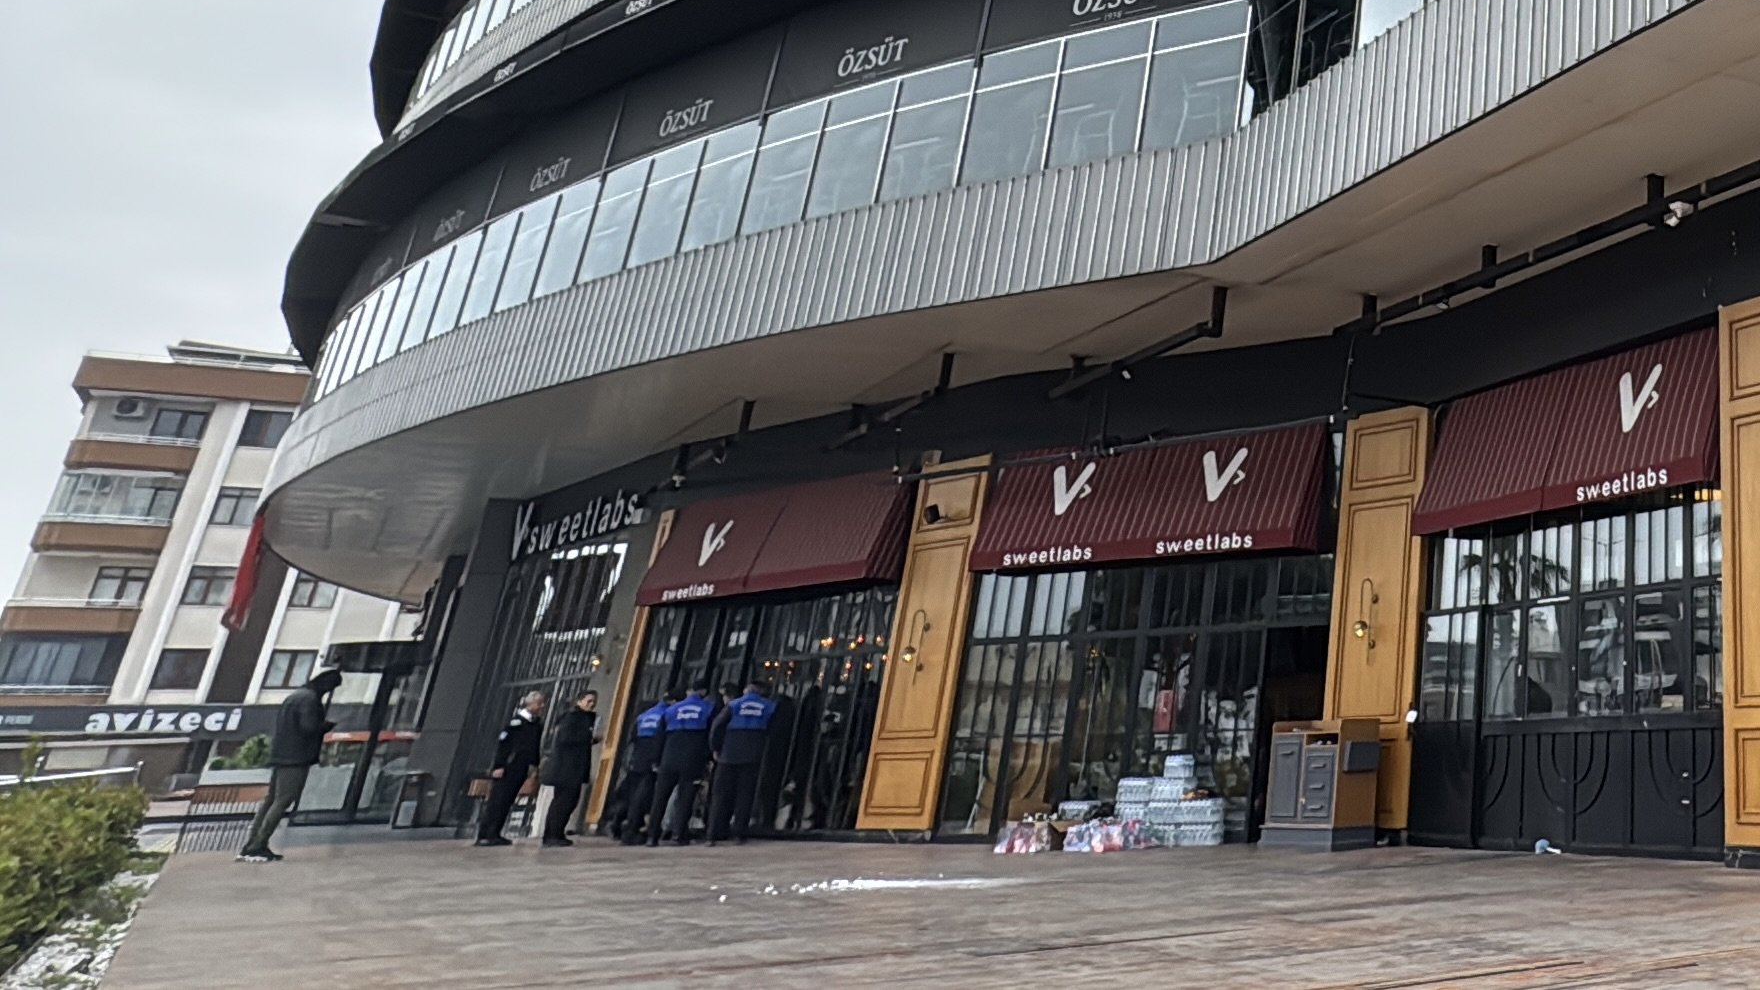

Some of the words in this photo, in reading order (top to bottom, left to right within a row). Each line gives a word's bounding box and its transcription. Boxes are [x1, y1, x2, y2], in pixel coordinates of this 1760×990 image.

[837, 36, 909, 77] ÖZSÜT
[659, 98, 714, 138] ÖZSÜT
[529, 157, 572, 192] ÖZSÜT
[1576, 467, 1668, 502] sweetlabs
[527, 488, 639, 555] sweetlabs
[1003, 545, 1093, 566] sweetlabs
[1155, 533, 1253, 555] sweetlabs
[662, 583, 715, 602] sweetlabs
[85, 708, 242, 733] avizeci
